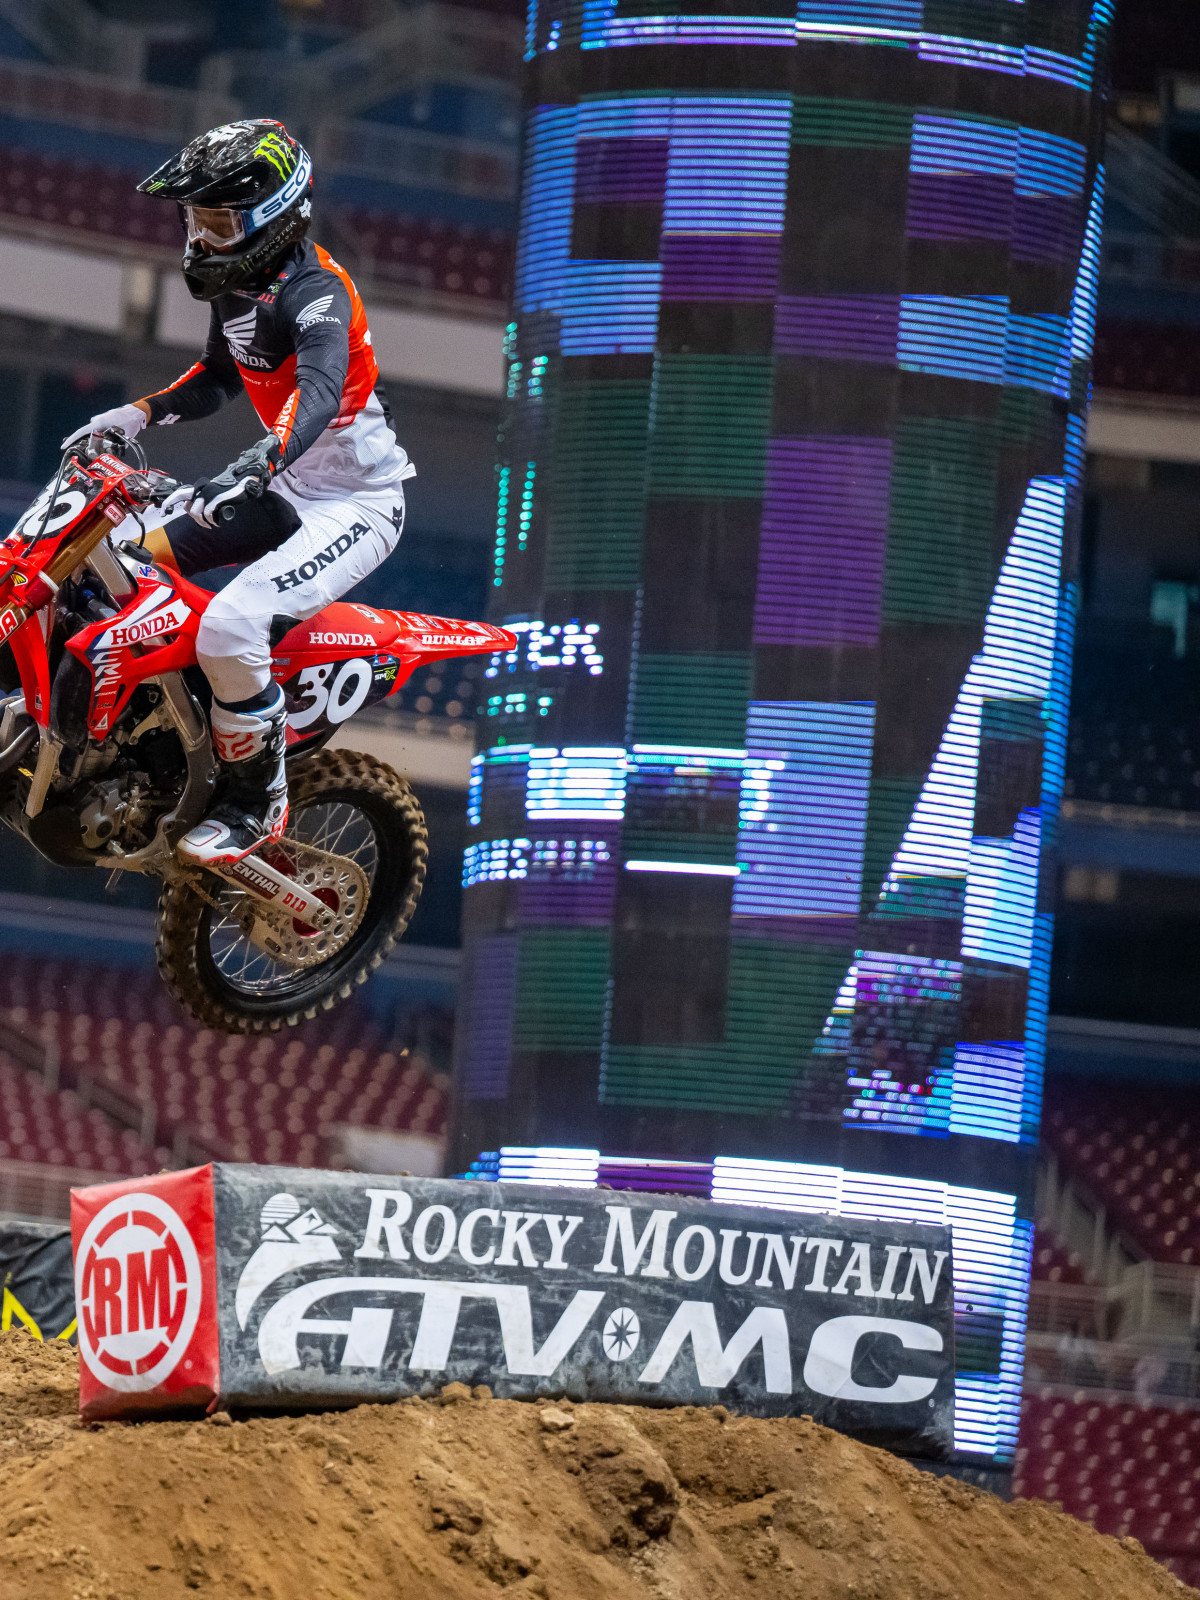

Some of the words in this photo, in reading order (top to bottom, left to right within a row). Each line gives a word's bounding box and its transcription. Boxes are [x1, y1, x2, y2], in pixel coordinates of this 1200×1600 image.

[300, 315, 341, 333] HONDA
[227, 342, 273, 369] HONDA
[270, 519, 371, 593] HONDA
[110, 612, 180, 646] HONDA
[309, 632, 378, 647] HONDA
[421, 634, 487, 647] DUNLOP
[287, 657, 373, 724] 30
[232, 863, 278, 895] ENTHAL
[283, 892, 307, 912] DID
[354, 1188, 584, 1270] ROCKY
[593, 1205, 948, 1305] MOUNTAIN
[90, 1248, 171, 1337] RM
